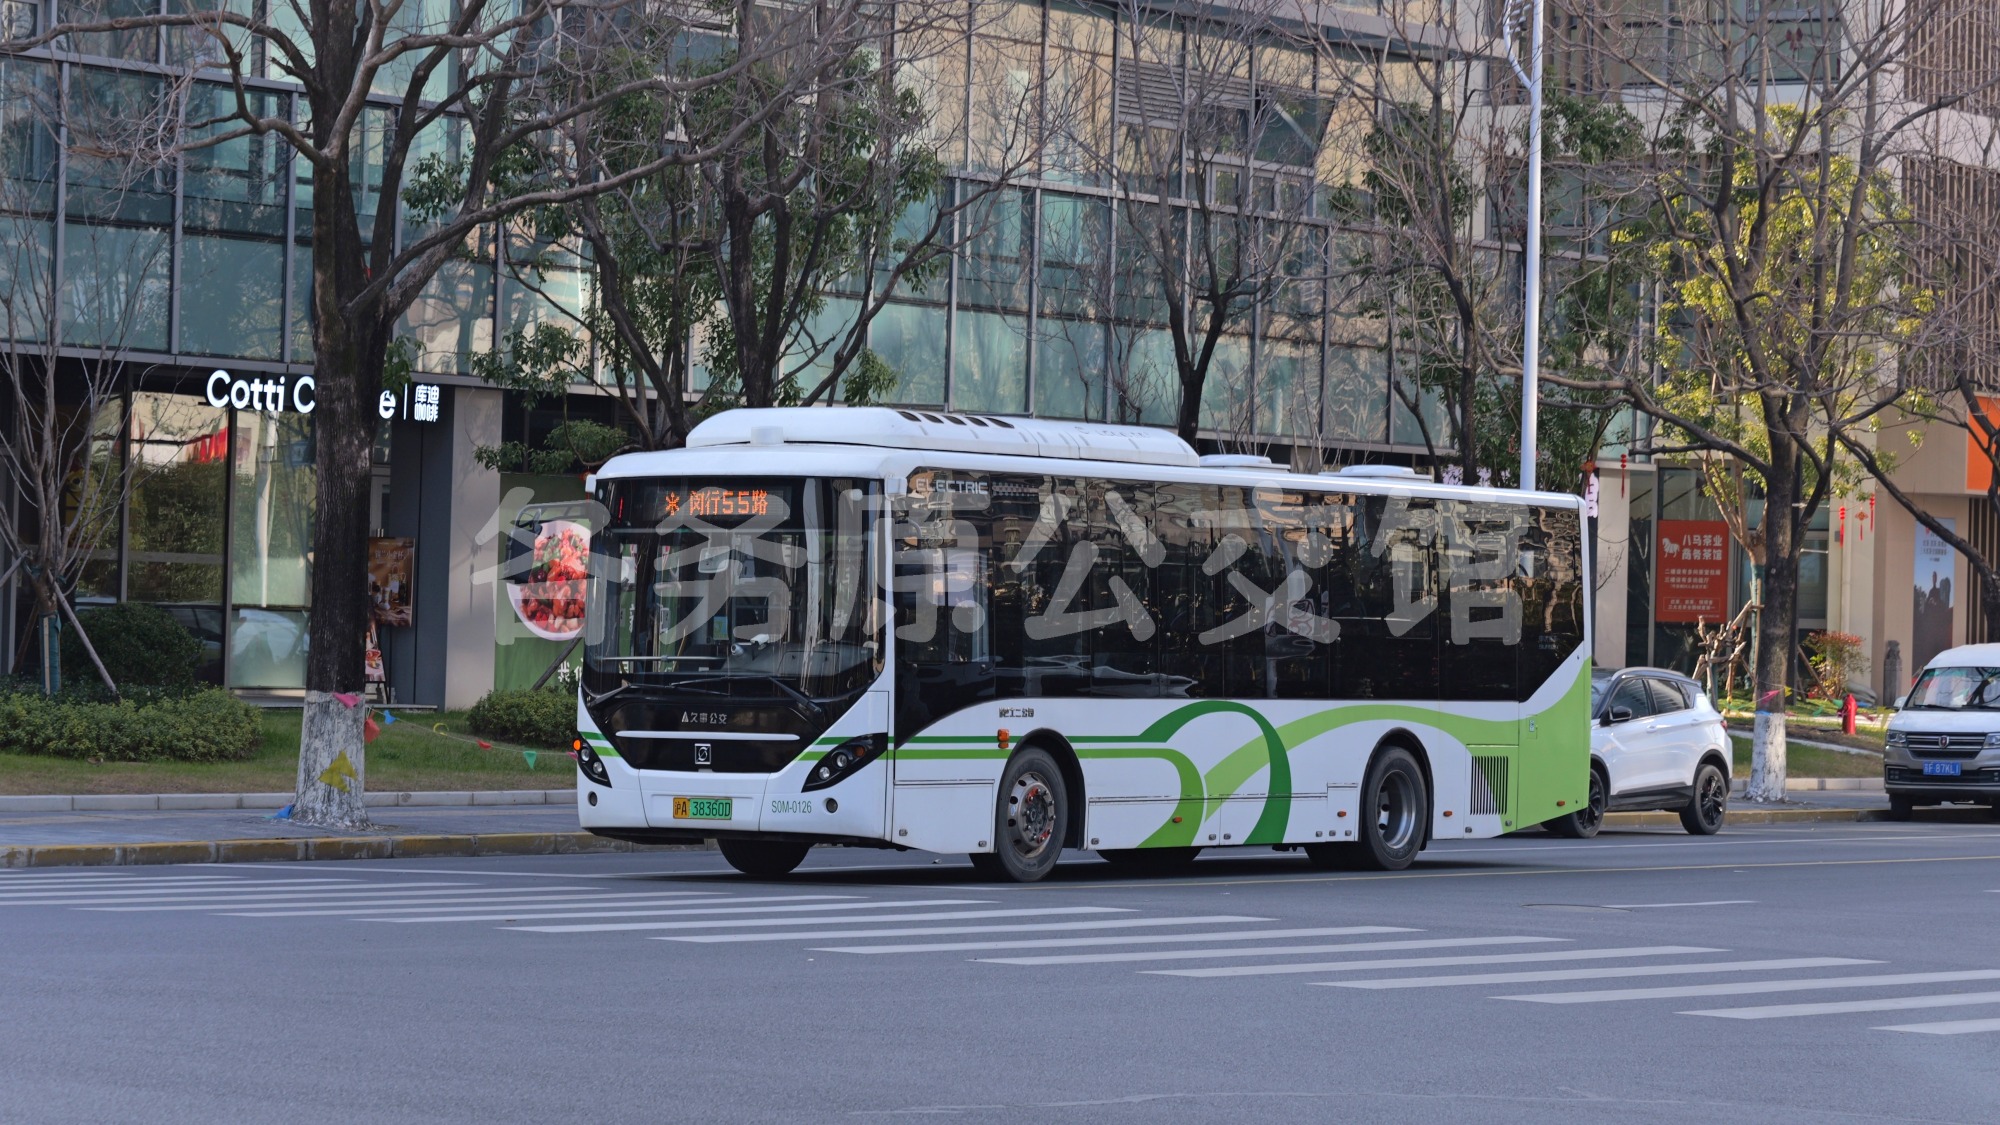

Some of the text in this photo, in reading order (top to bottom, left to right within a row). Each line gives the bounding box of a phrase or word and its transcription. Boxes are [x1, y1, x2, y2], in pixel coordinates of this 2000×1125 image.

[206, 369, 285, 412] Cotti
[414, 385, 440, 403] 库迪
[414, 403, 439, 422] 咖啡
[915, 478, 988, 495] ELECTRIC
[688, 490, 769, 516] 闵行55路
[1682, 534, 1723, 547] 八马茶业
[1681, 548, 1722, 560] 商务茶馆
[690, 711, 727, 725] 久事公交
